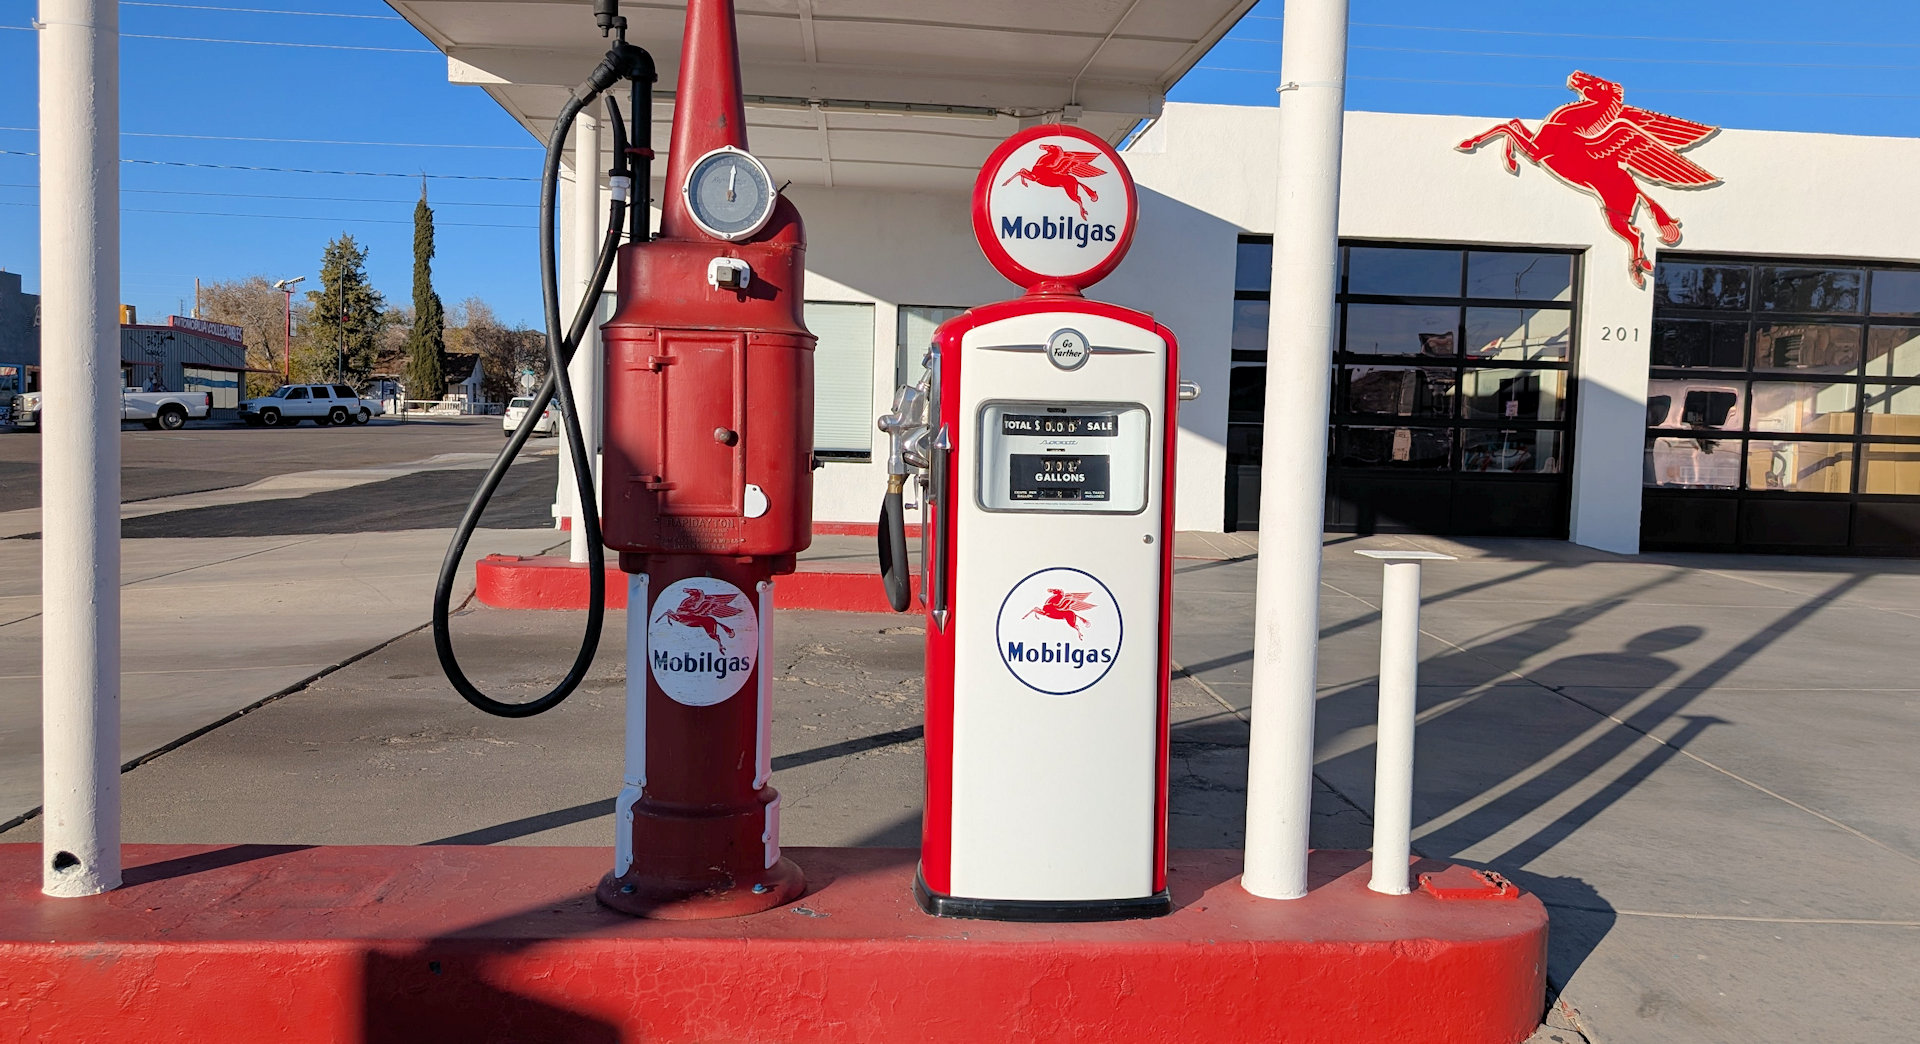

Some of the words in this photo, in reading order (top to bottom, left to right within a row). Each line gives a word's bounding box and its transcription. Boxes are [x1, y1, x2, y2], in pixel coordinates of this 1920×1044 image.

[1001, 215, 1116, 249] Mobilgas
[1601, 326, 1639, 342] 201
[1062, 339, 1073, 348] Go
[1054, 348, 1082, 357] Farther
[1004, 420, 1032, 430] TOTAL
[1034, 420, 1040, 431] $
[1087, 422, 1113, 431] SALE
[1035, 473, 1085, 482] GALLONS
[1008, 641, 1112, 669] Mobilgas
[654, 649, 750, 680] Mobilgas
